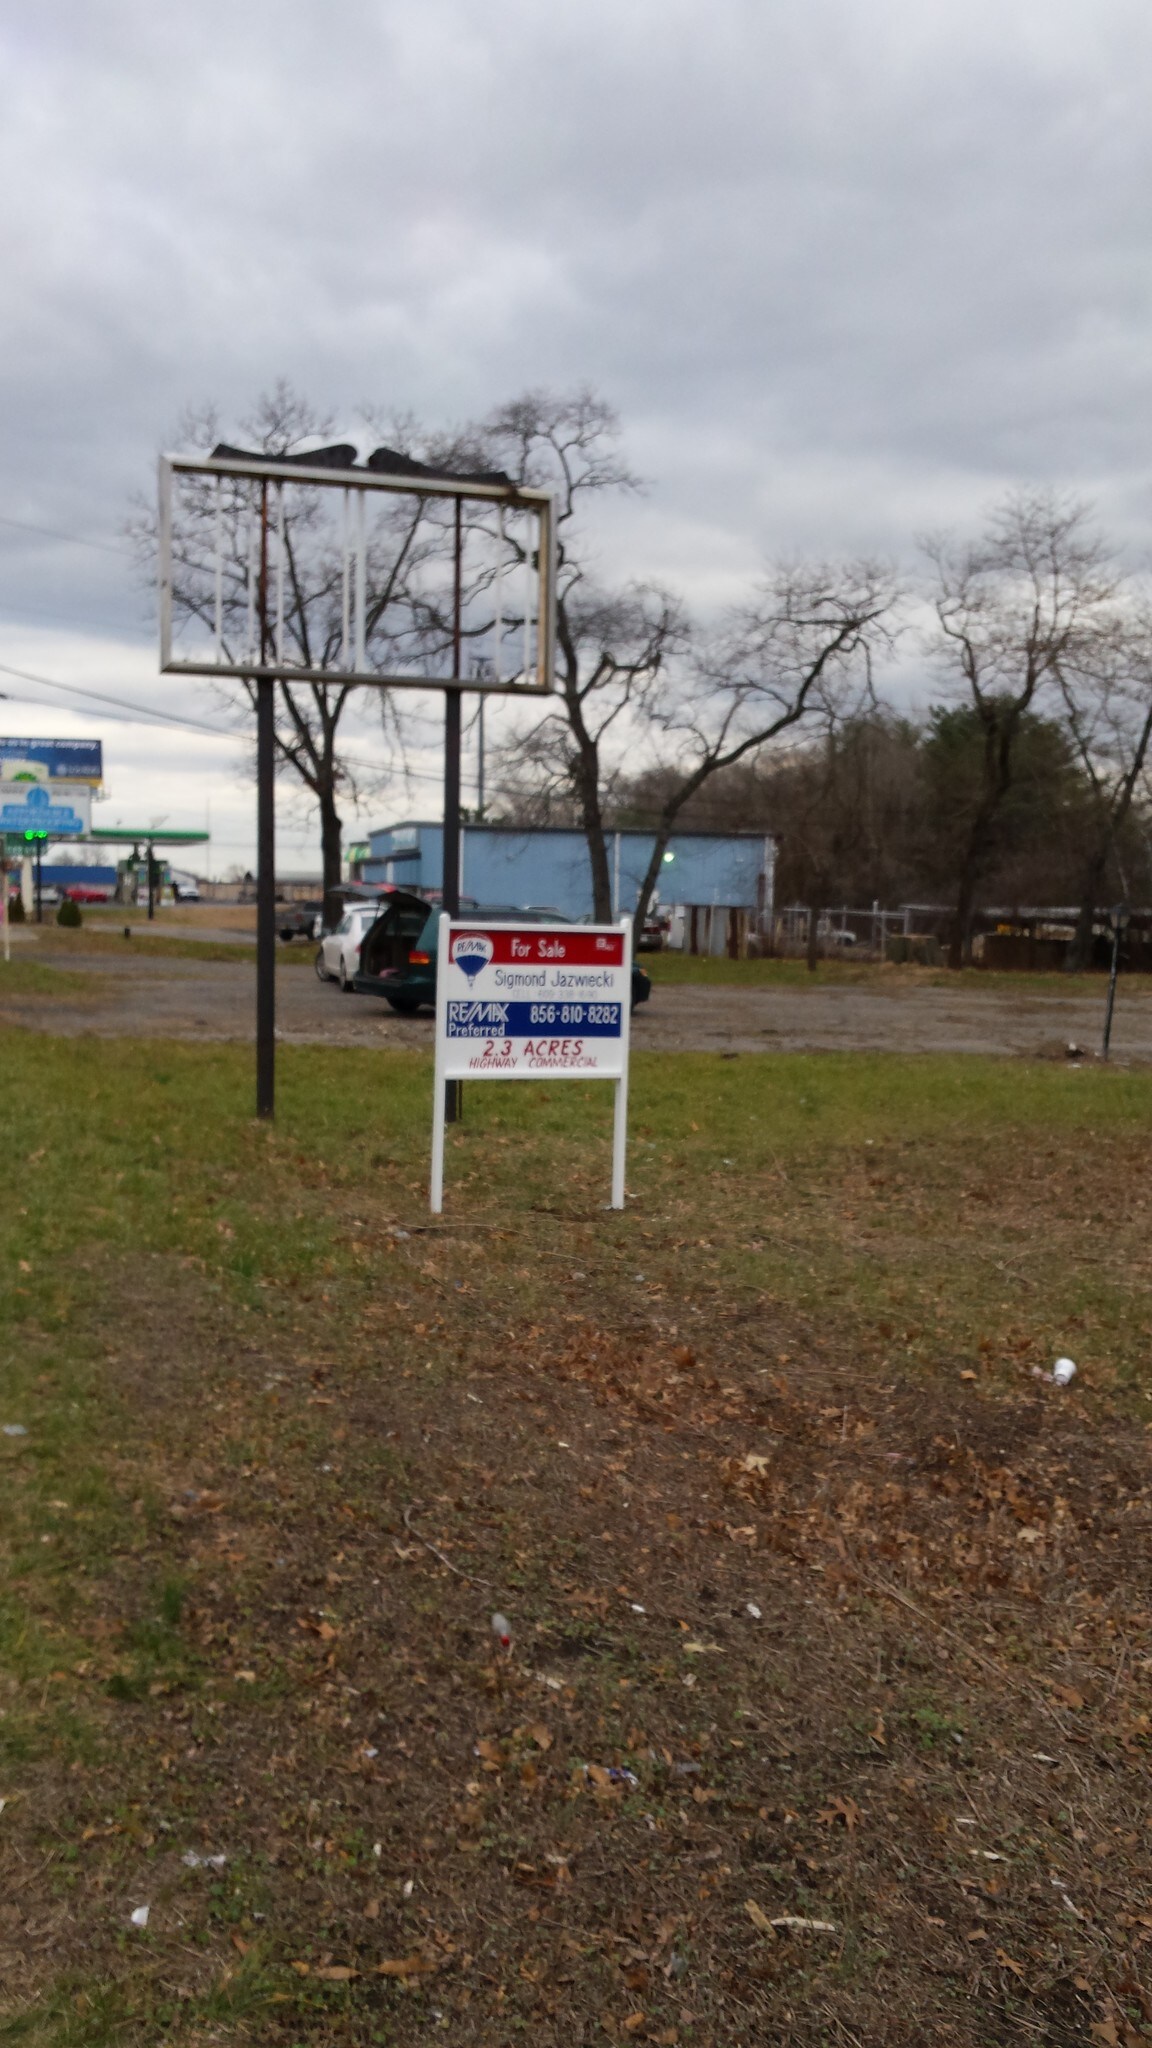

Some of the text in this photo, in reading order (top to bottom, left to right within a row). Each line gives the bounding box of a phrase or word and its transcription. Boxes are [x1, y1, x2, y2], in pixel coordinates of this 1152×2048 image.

[457, 942, 487, 952] RE/MAX
[511, 939, 566, 958] For Sale
[495, 969, 614, 989] Sigmond Jazwiecki
[450, 1003, 509, 1023] RE/MAX
[530, 1005, 617, 1024] 856-810-8282
[450, 1024, 505, 1037] Preferred
[483, 1040, 583, 1057] 2.3 ACRES
[469, 1057, 598, 1069] HIGHWAY COMMERCIAL
